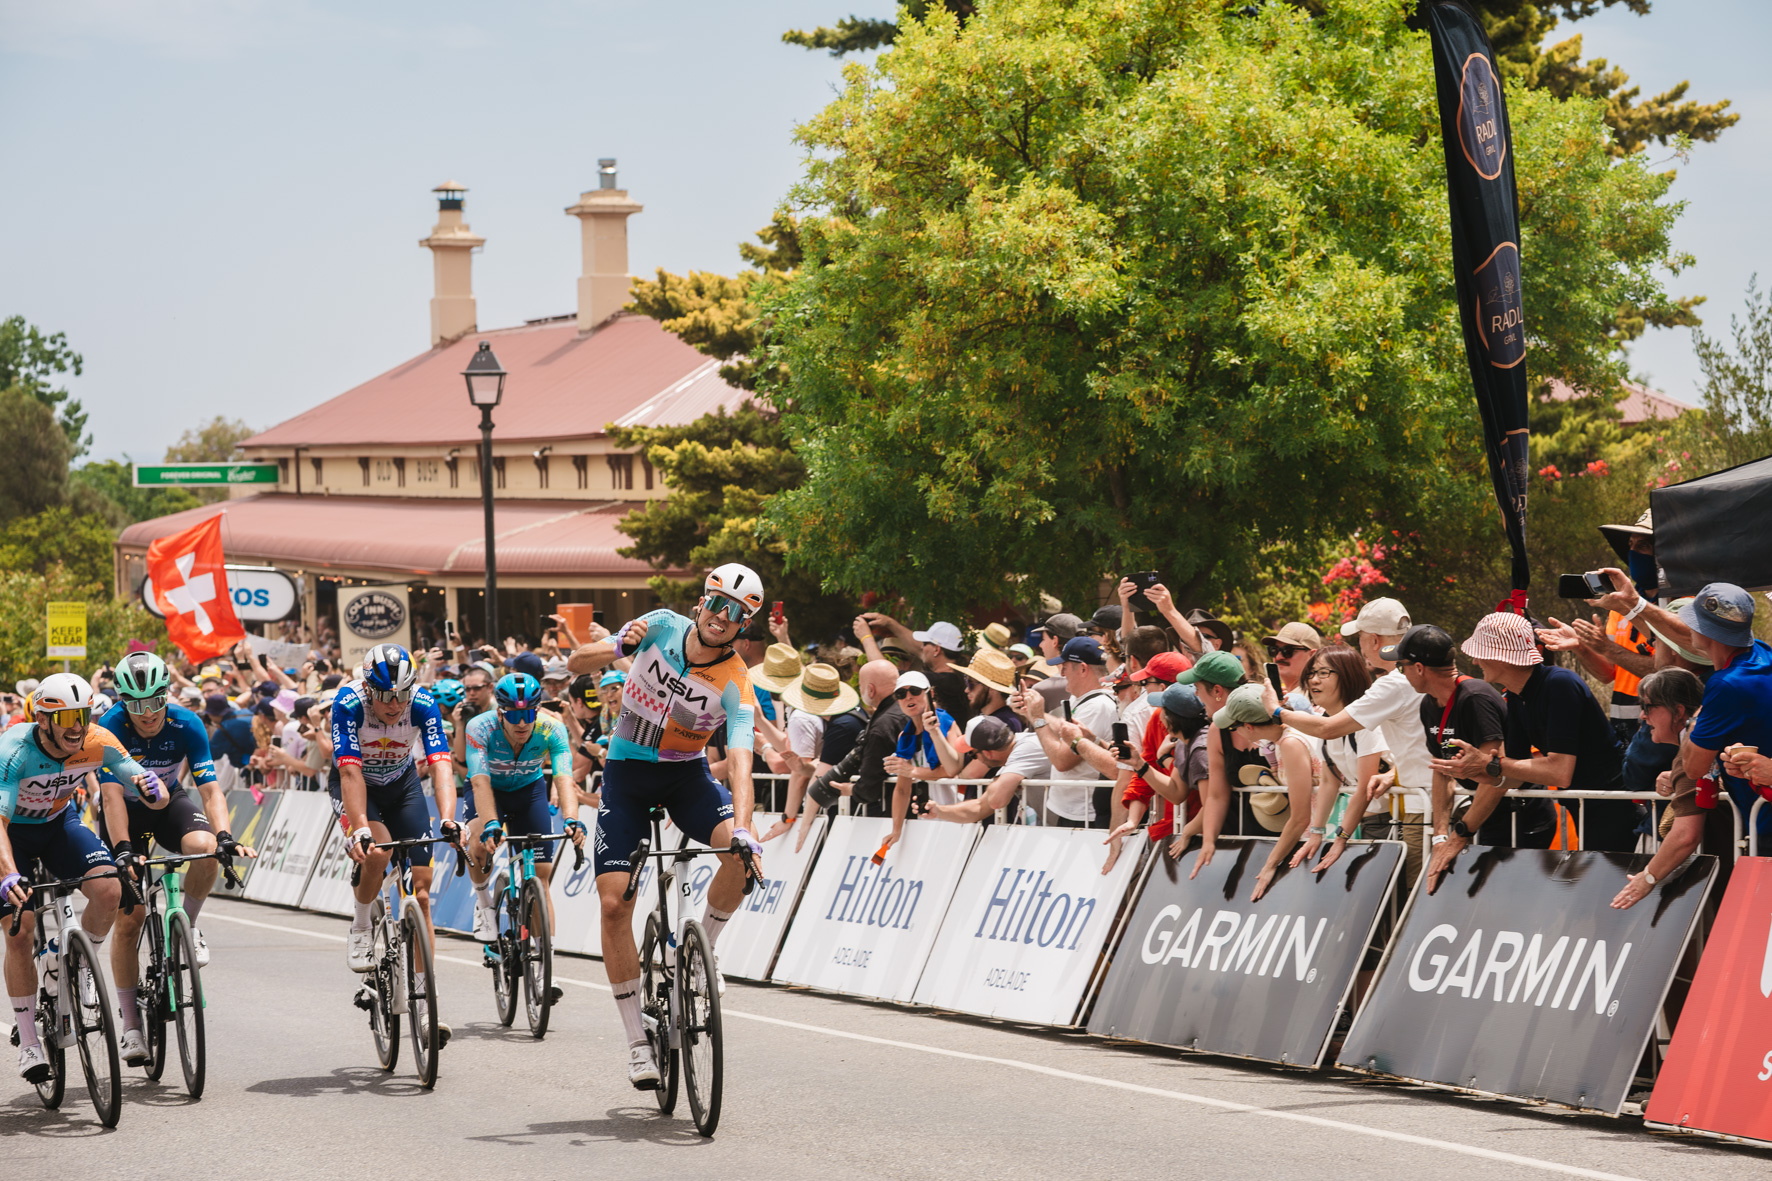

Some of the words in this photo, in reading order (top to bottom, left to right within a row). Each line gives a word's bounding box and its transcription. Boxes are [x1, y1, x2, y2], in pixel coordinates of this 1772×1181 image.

[1475, 118, 1497, 144] RADL
[1491, 307, 1523, 334] RADL
[349, 596, 370, 616] OLD
[372, 594, 400, 614] BUSH
[364, 605, 385, 615] INN
[51, 626, 83, 636] KEEP
[51, 635, 84, 646] CLEAR
[415, 692, 435, 705] BORA
[346, 719, 360, 752] BOSS
[425, 717, 441, 747] BOSS
[488, 765, 545, 776] STAN
[825, 855, 924, 931] Hilton
[974, 867, 1097, 951] Hilton
[1140, 904, 1328, 984] GARMIN
[831, 946, 873, 969] ADELAIDE
[1408, 923, 1632, 1016] GARMIN
[983, 967, 1031, 993] ADELAIDE
